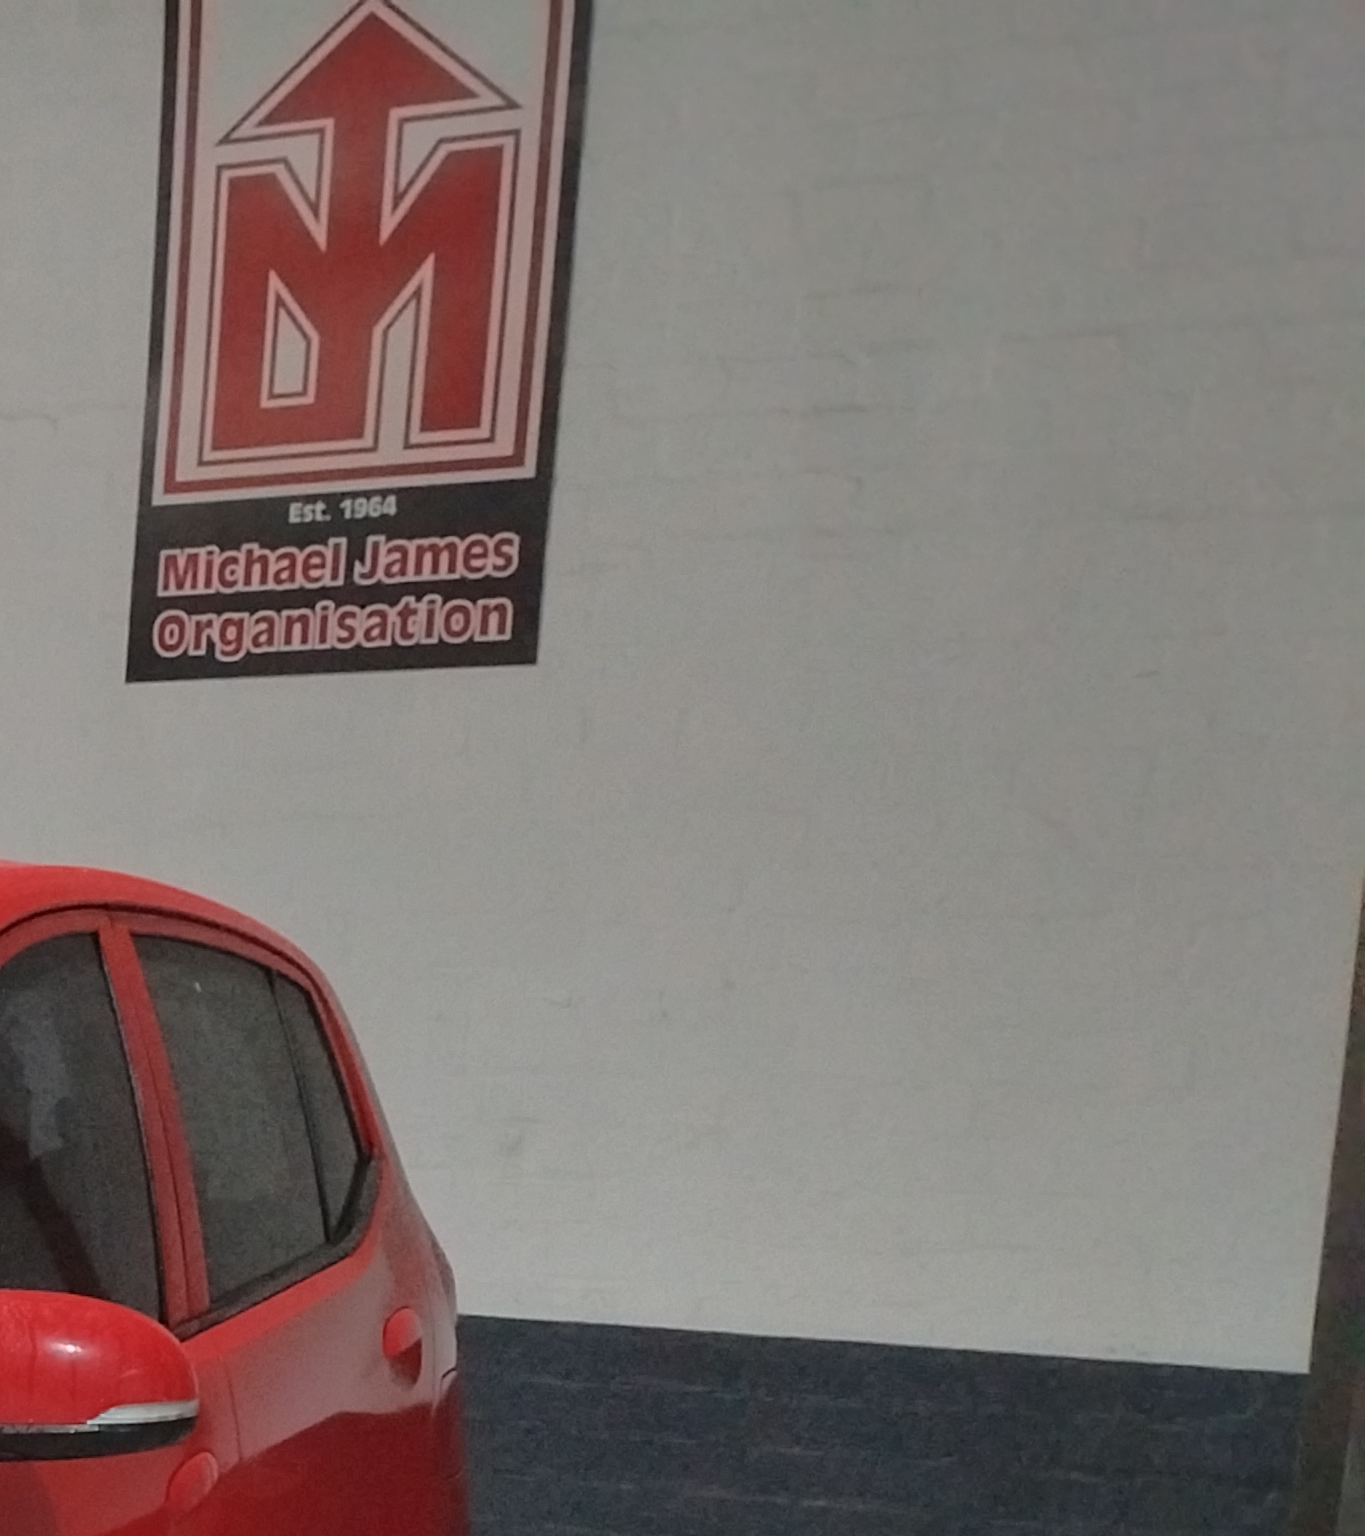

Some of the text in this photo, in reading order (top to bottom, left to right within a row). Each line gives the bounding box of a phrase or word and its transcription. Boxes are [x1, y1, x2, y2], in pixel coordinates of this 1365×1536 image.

[288, 495, 397, 524] Est. 1964
[158, 531, 520, 597] Michael James
[152, 595, 513, 661] Organisation
